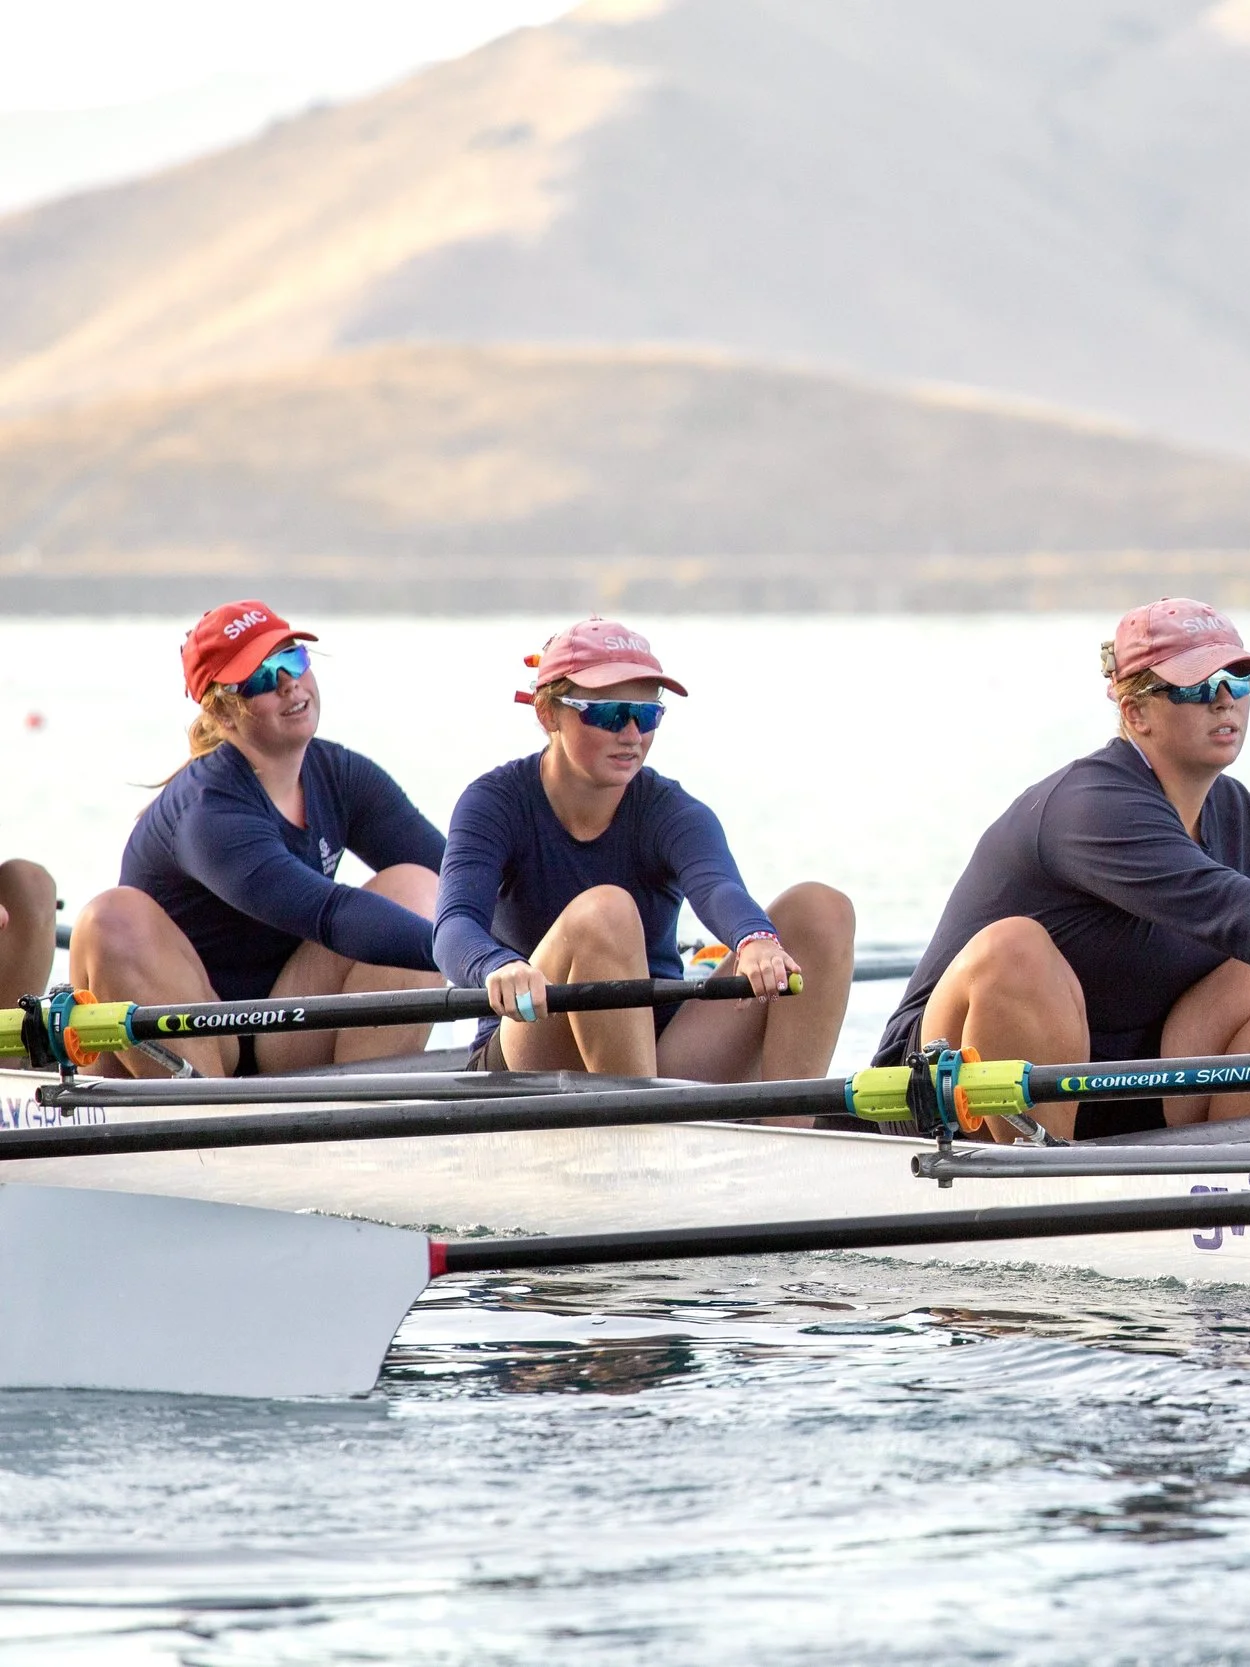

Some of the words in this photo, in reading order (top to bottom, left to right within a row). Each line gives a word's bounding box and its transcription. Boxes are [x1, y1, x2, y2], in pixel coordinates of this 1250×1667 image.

[223, 610, 267, 640] SMC
[193, 1009, 286, 1028] concept
[292, 1008, 305, 1022] 2
[1091, 1072, 1169, 1088] concept
[1174, 1071, 1185, 1083] 2
